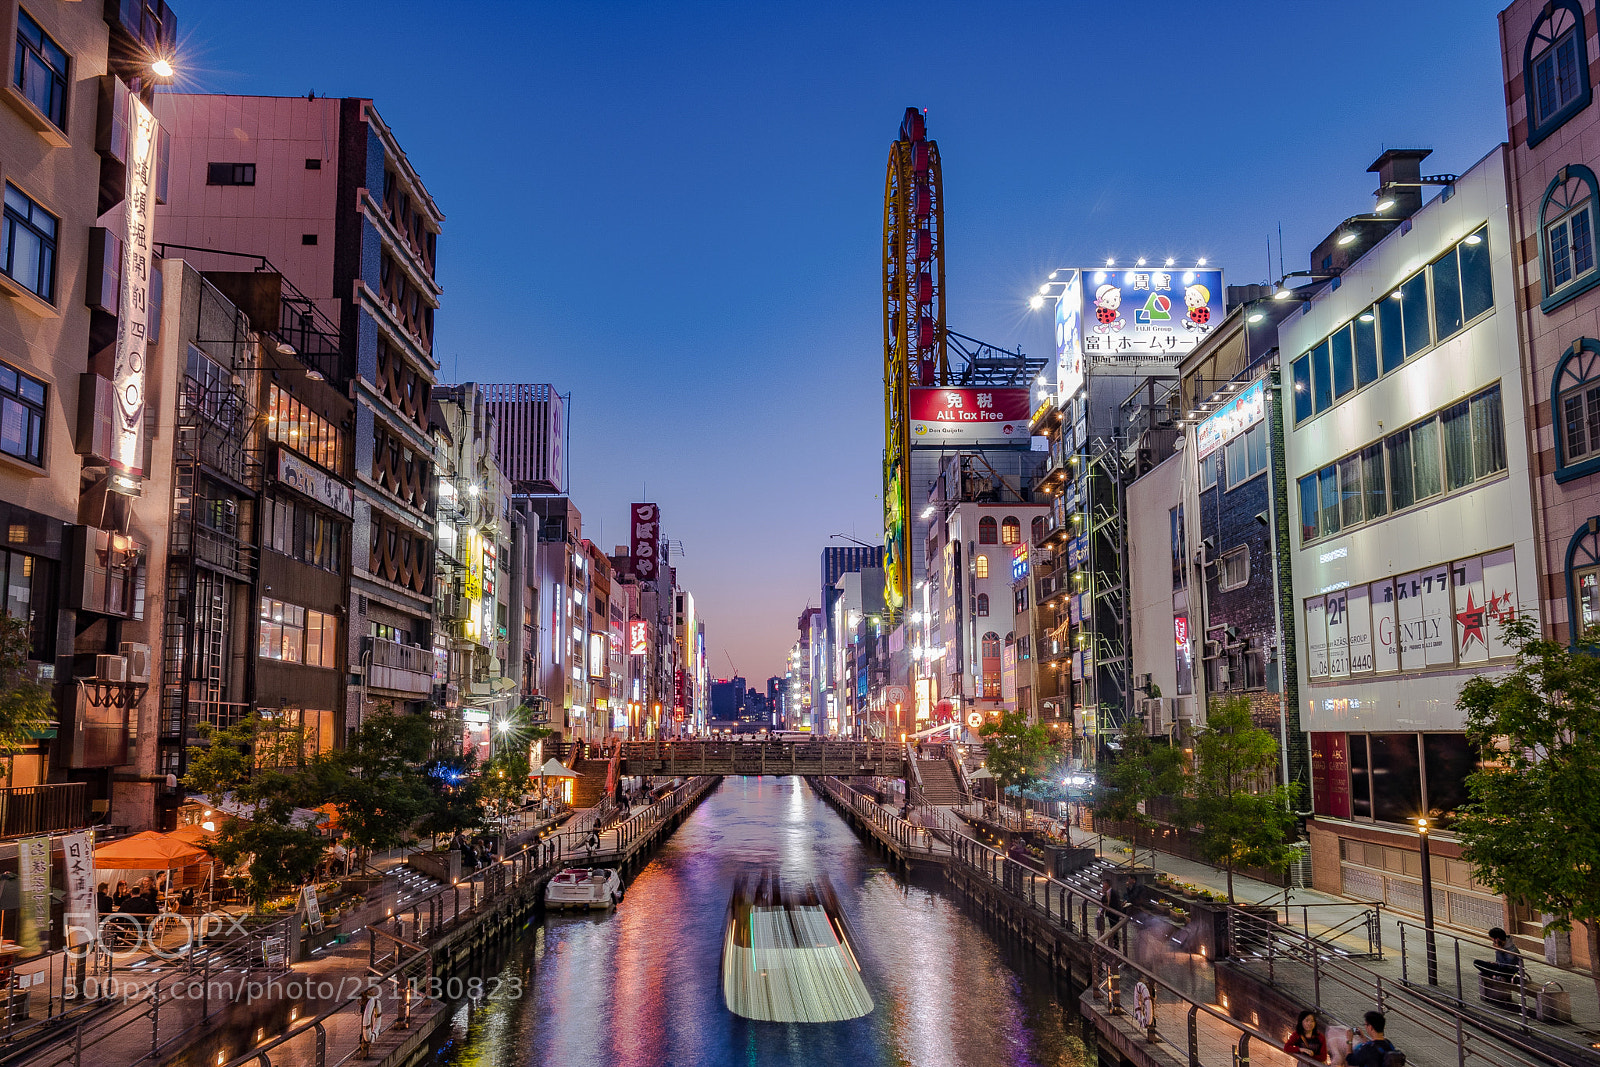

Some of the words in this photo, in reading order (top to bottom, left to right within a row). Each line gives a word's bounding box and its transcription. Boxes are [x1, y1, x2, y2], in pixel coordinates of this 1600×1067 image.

[1135, 274, 1171, 291] 賃貸
[936, 410, 955, 420] ALL
[958, 410, 977, 420] Tax
[980, 410, 1004, 420] Free
[636, 504, 655, 576] づぼらや
[1384, 563, 1465, 603] ホストクラブ
[1329, 597, 1345, 626] 2F
[1319, 661, 1327, 674] 06
[1331, 658, 1348, 673] 6211
[1352, 655, 1371, 671] 4440
